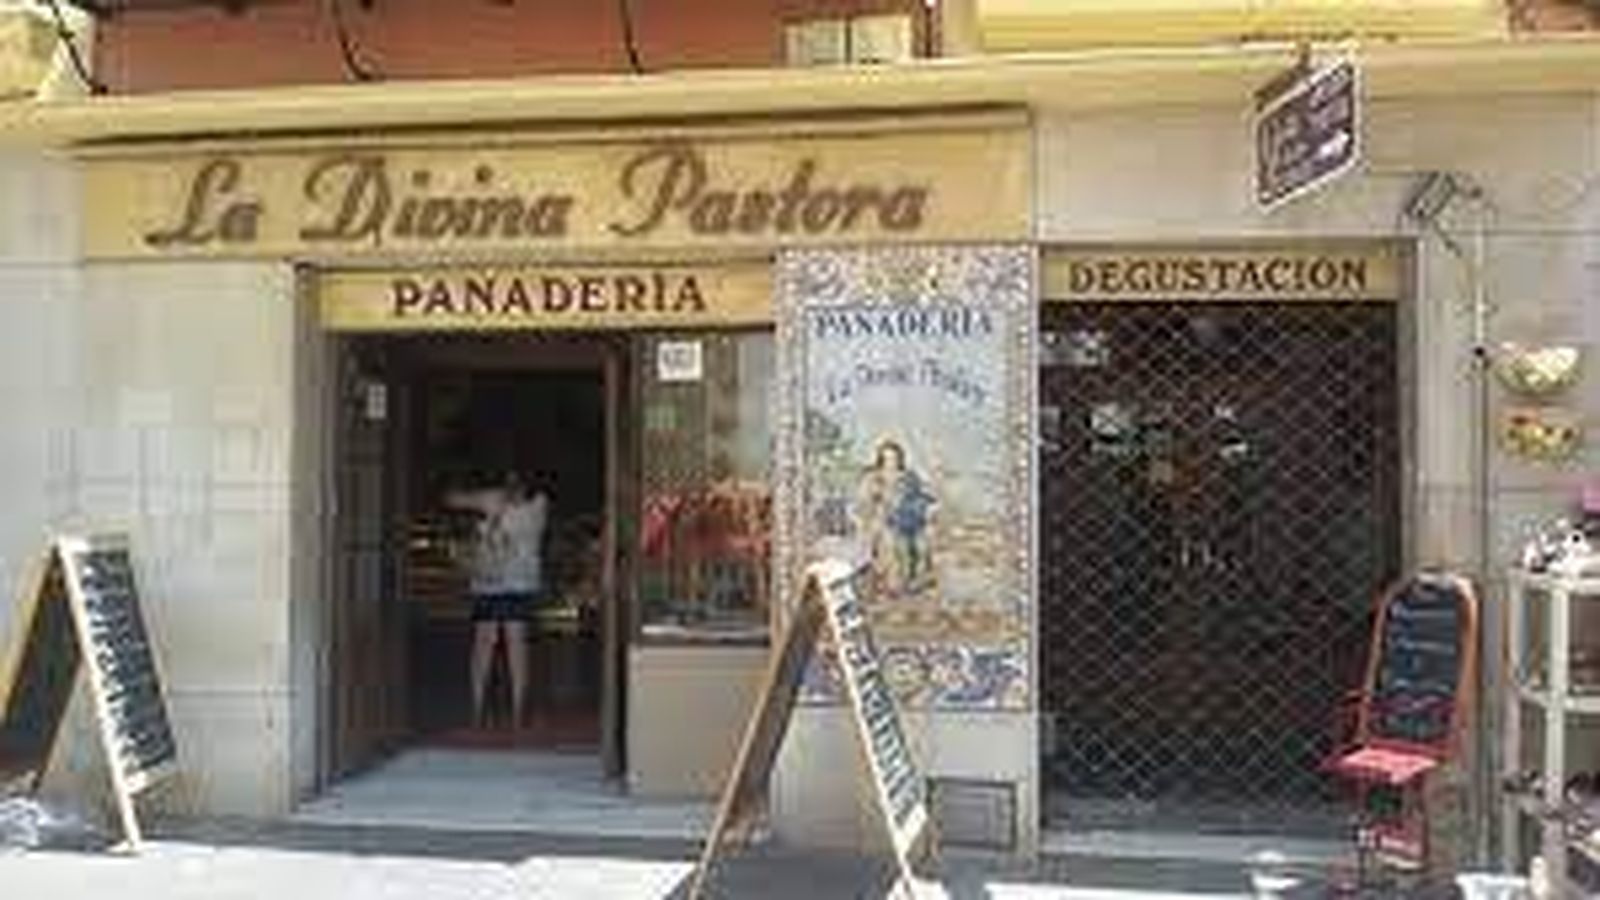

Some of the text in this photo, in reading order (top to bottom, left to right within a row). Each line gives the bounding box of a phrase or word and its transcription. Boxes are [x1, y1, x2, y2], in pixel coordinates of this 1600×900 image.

[144, 136, 931, 246] La Divina Pastora
